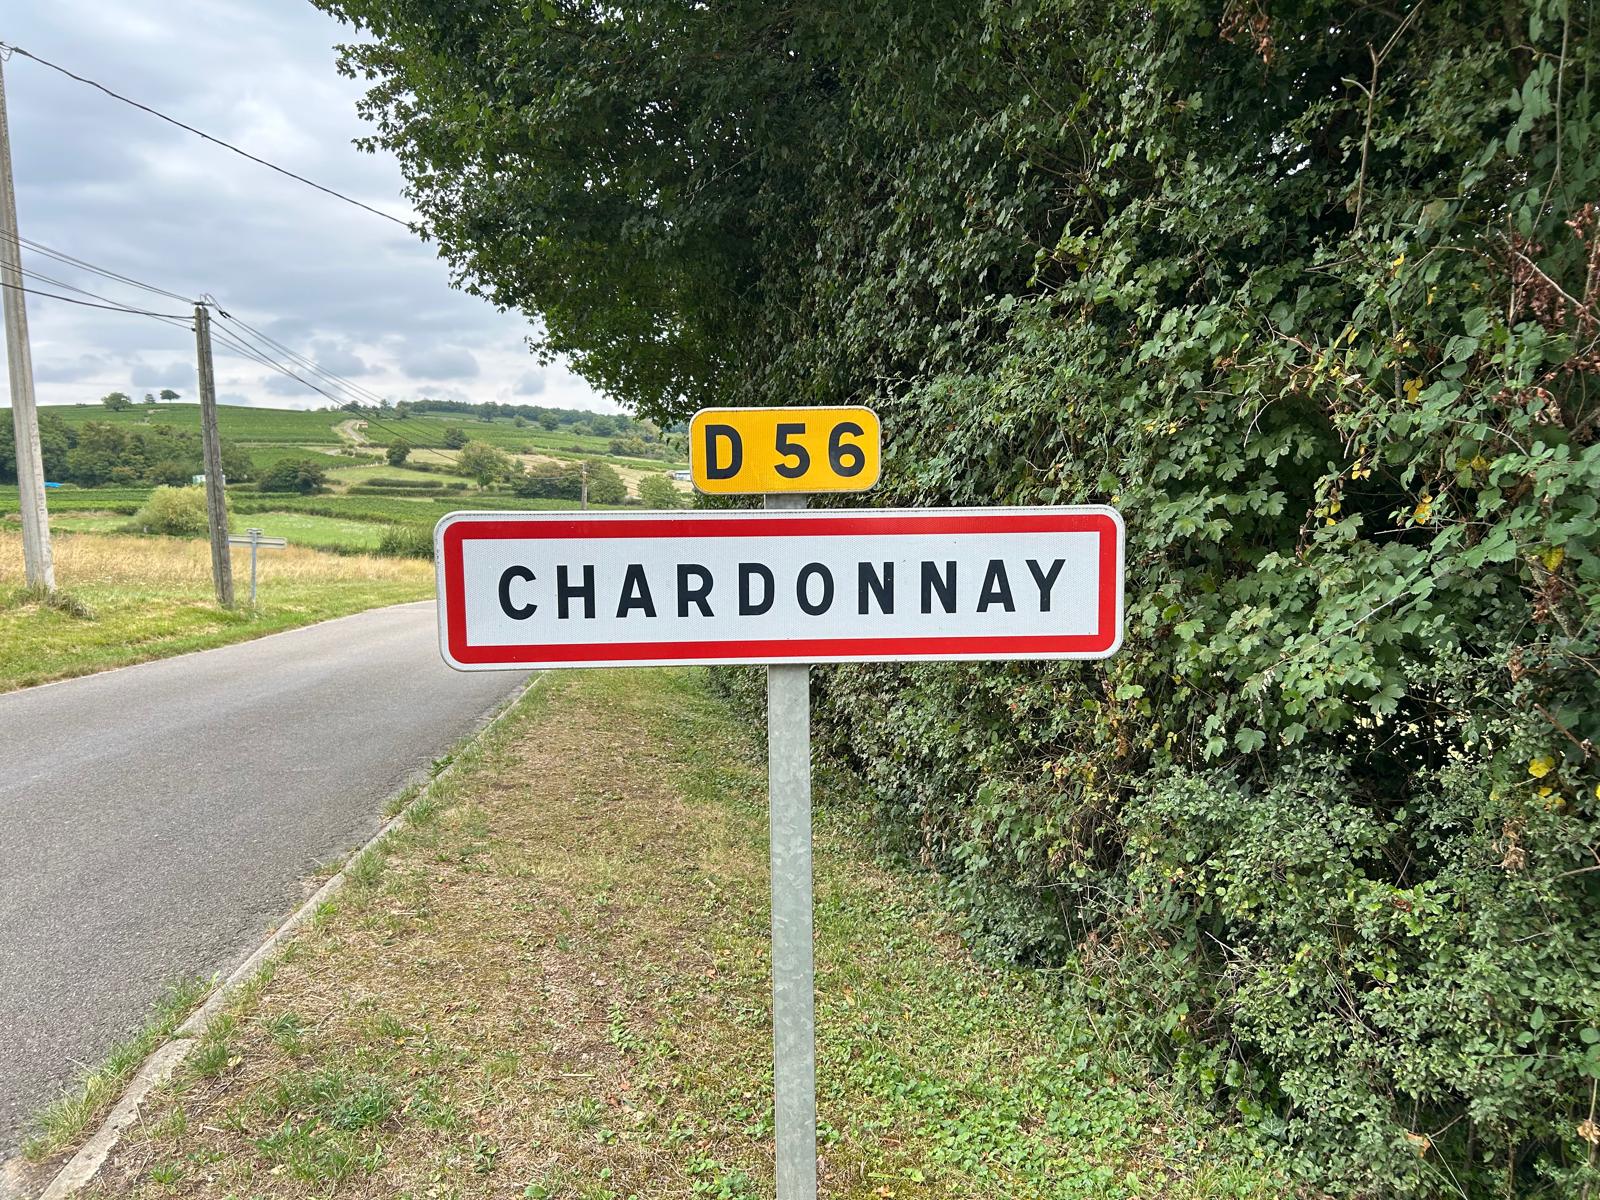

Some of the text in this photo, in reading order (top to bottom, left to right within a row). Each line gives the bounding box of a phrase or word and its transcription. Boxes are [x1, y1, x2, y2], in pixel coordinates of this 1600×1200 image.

[705, 421, 865, 480] D 56
[499, 558, 1065, 620] CHARDONNAY
